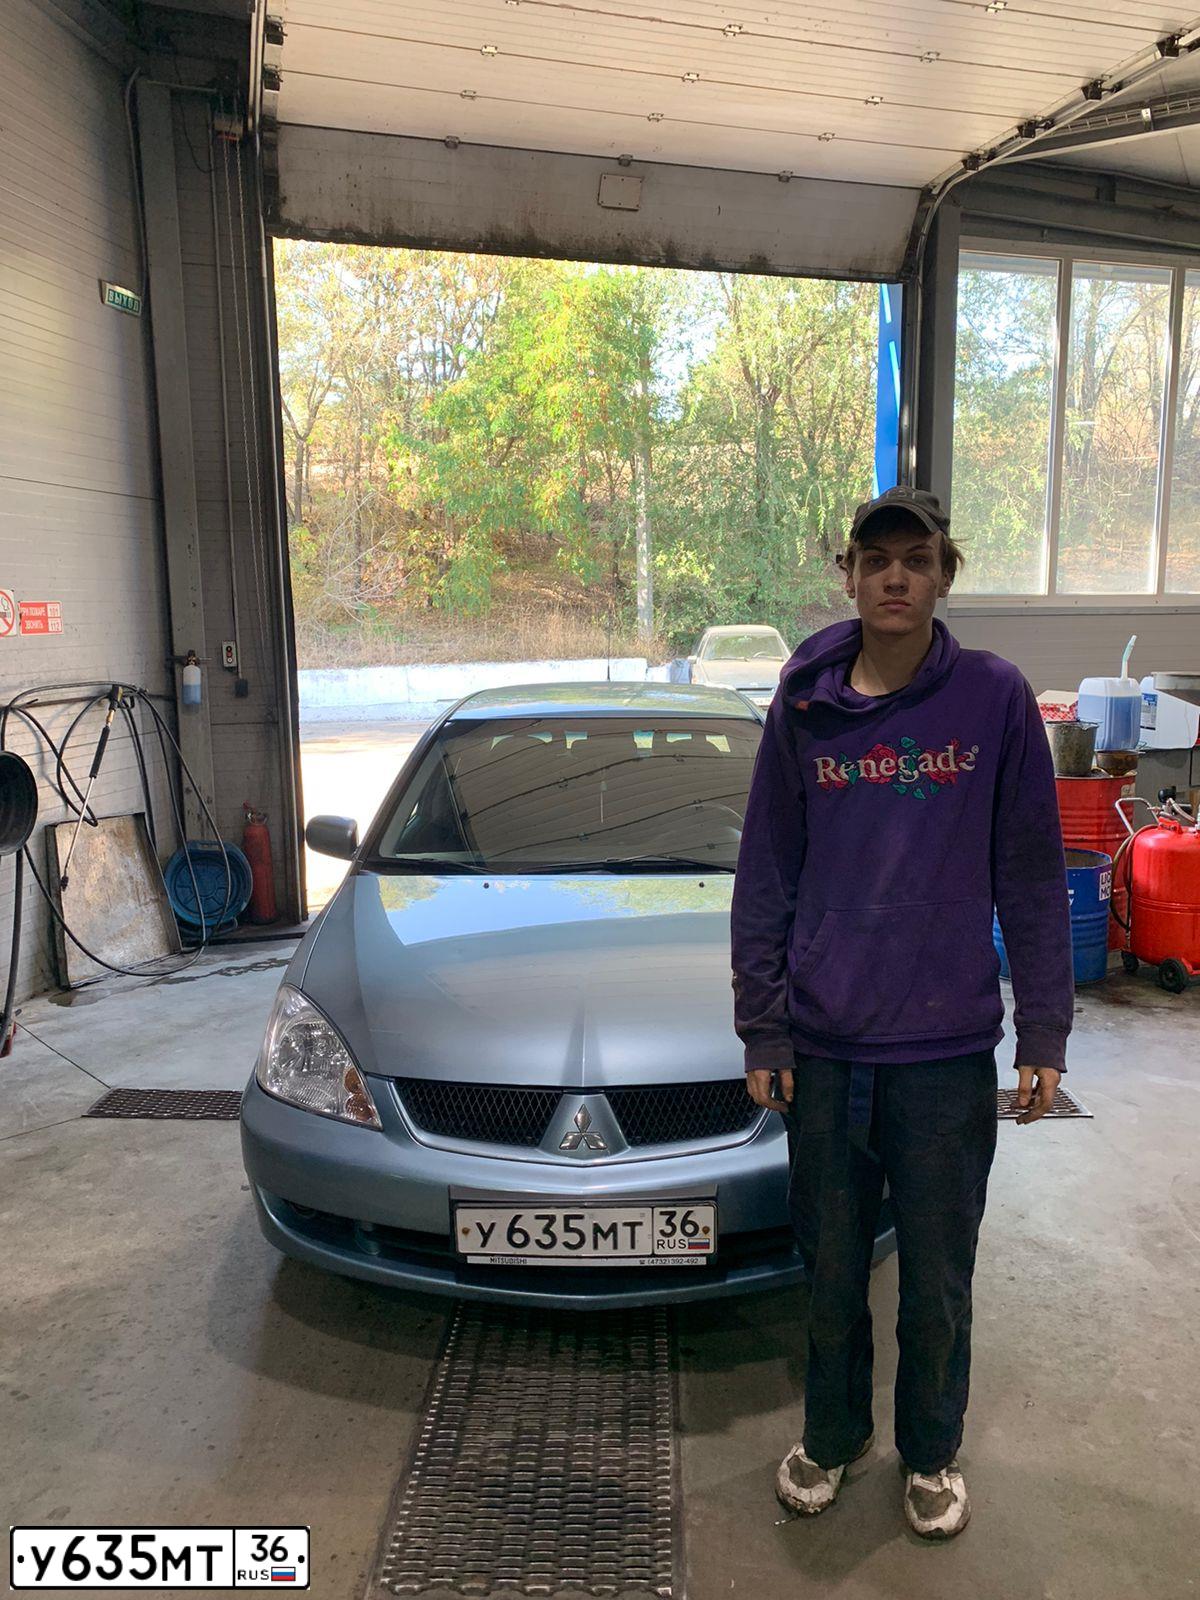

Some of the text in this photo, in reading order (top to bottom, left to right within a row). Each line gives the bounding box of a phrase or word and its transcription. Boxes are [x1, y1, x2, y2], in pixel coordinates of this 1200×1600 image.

[108, 290, 139, 312] ВЫХОД
[51, 621, 60, 631] 112
[658, 1210, 700, 1237] 36
[656, 1238, 687, 1249] RUS
[489, 1257, 528, 1265] MITSUBISHI
